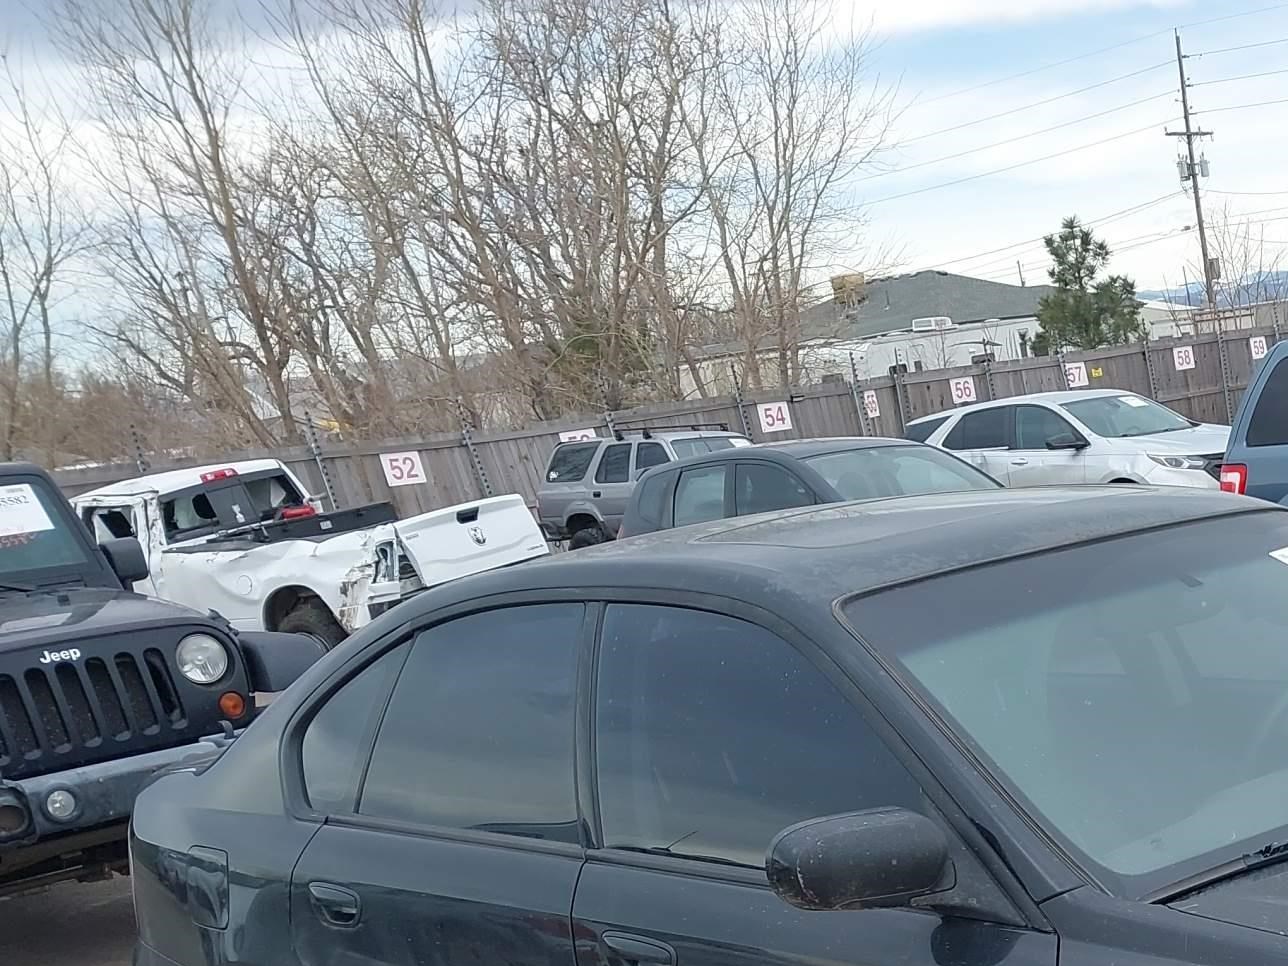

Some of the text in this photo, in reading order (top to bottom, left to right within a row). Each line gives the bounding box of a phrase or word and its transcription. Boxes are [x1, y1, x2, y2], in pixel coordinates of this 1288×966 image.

[1253, 340, 1265, 355] 59
[1176, 349, 1191, 366] 58
[1067, 366, 1082, 384] 57
[954, 380, 972, 399] 56
[764, 405, 786, 427] 54
[389, 456, 419, 480] 52
[39, 648, 81, 664] Jeep
